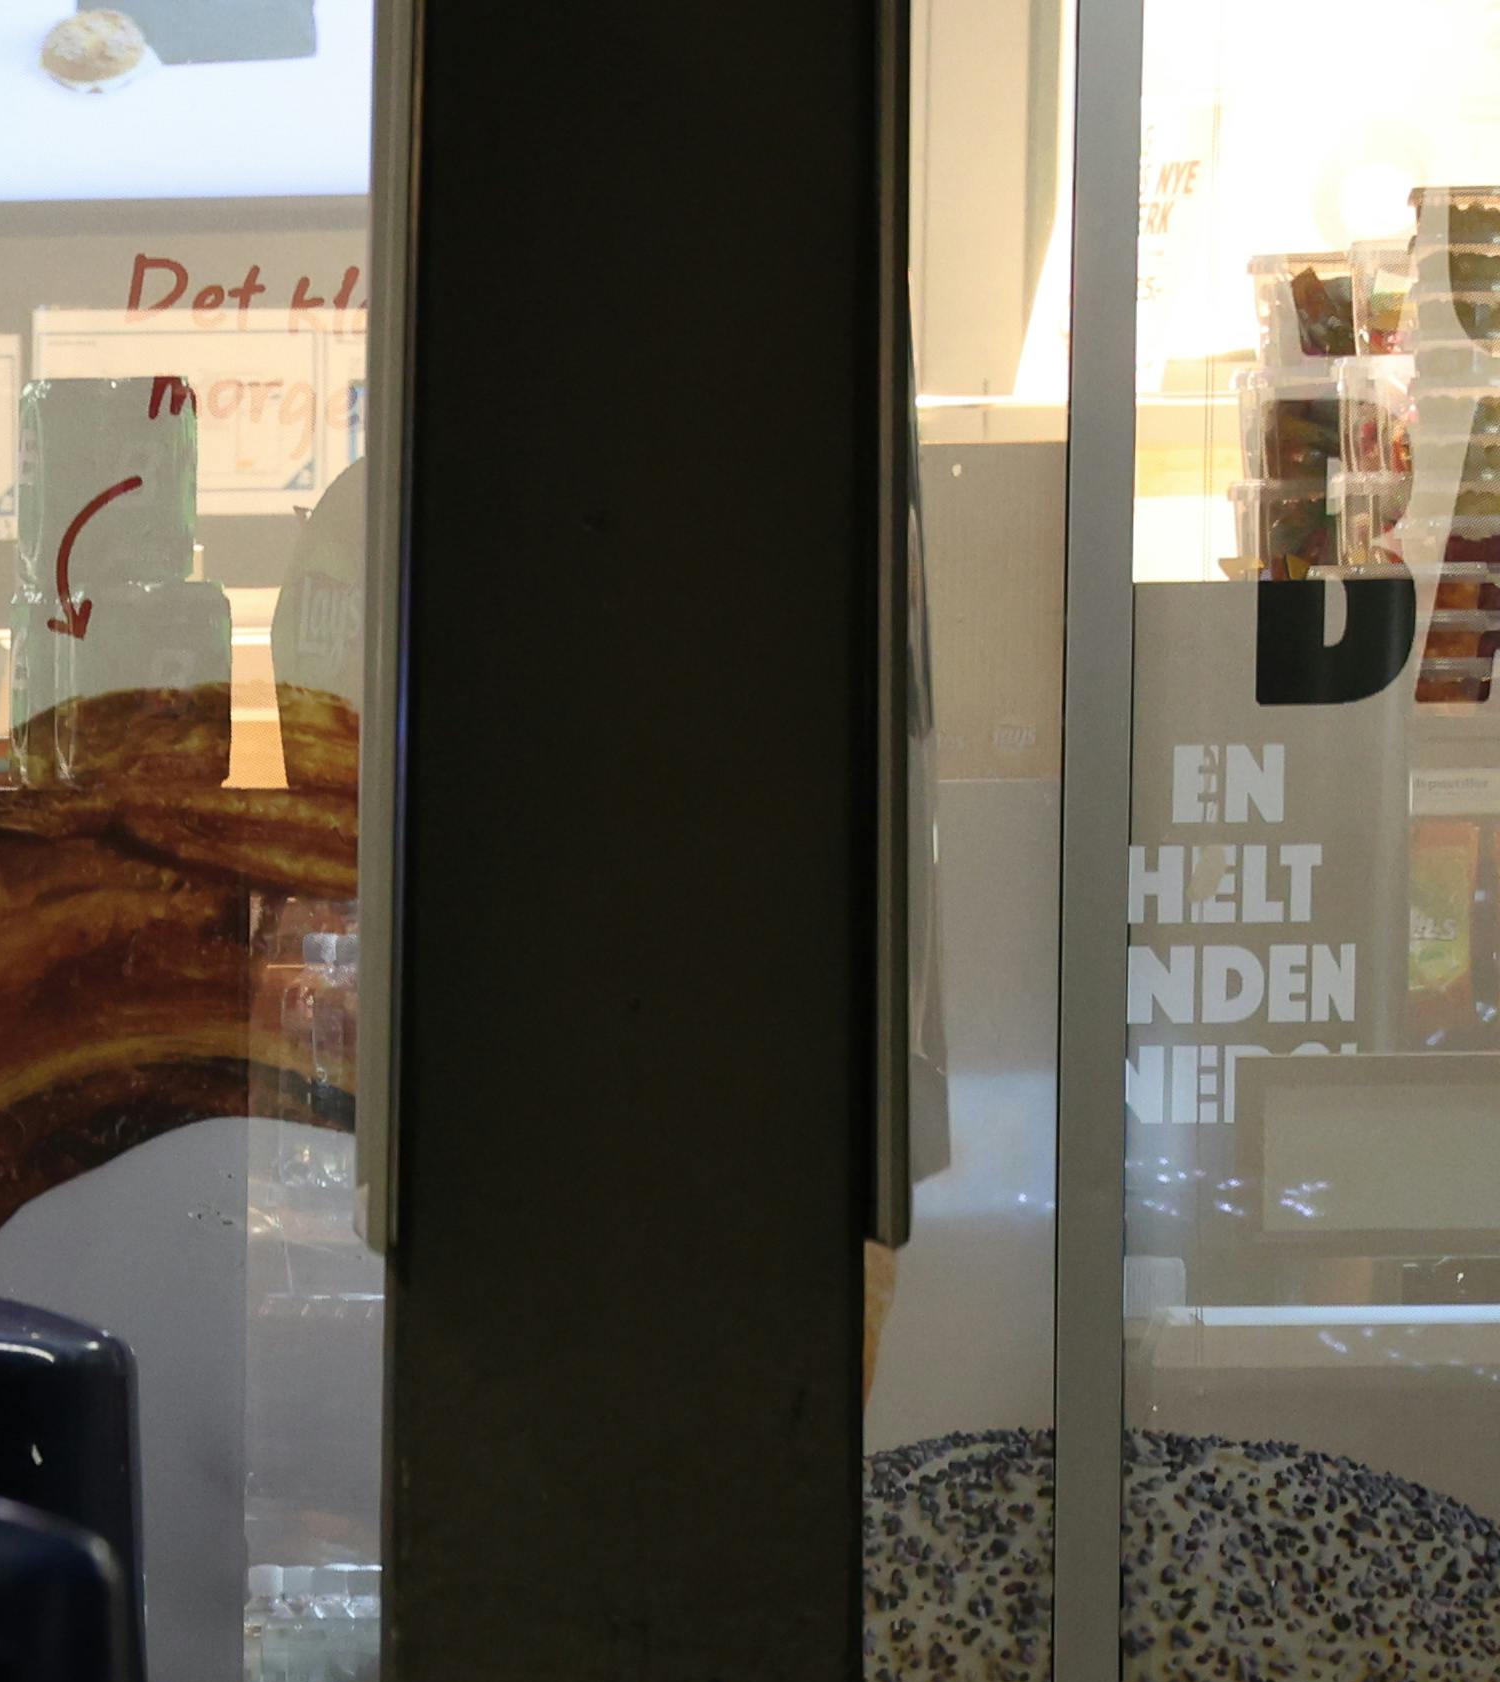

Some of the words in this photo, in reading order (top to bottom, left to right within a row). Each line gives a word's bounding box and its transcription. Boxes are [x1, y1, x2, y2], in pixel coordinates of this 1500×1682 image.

[125, 253, 266, 331] Det
[148, 375, 360, 459] morge
[1173, 745, 1285, 823] EN
[1129, 844, 1322, 923] HELT
[1128, 944, 1356, 1024] NDEN
